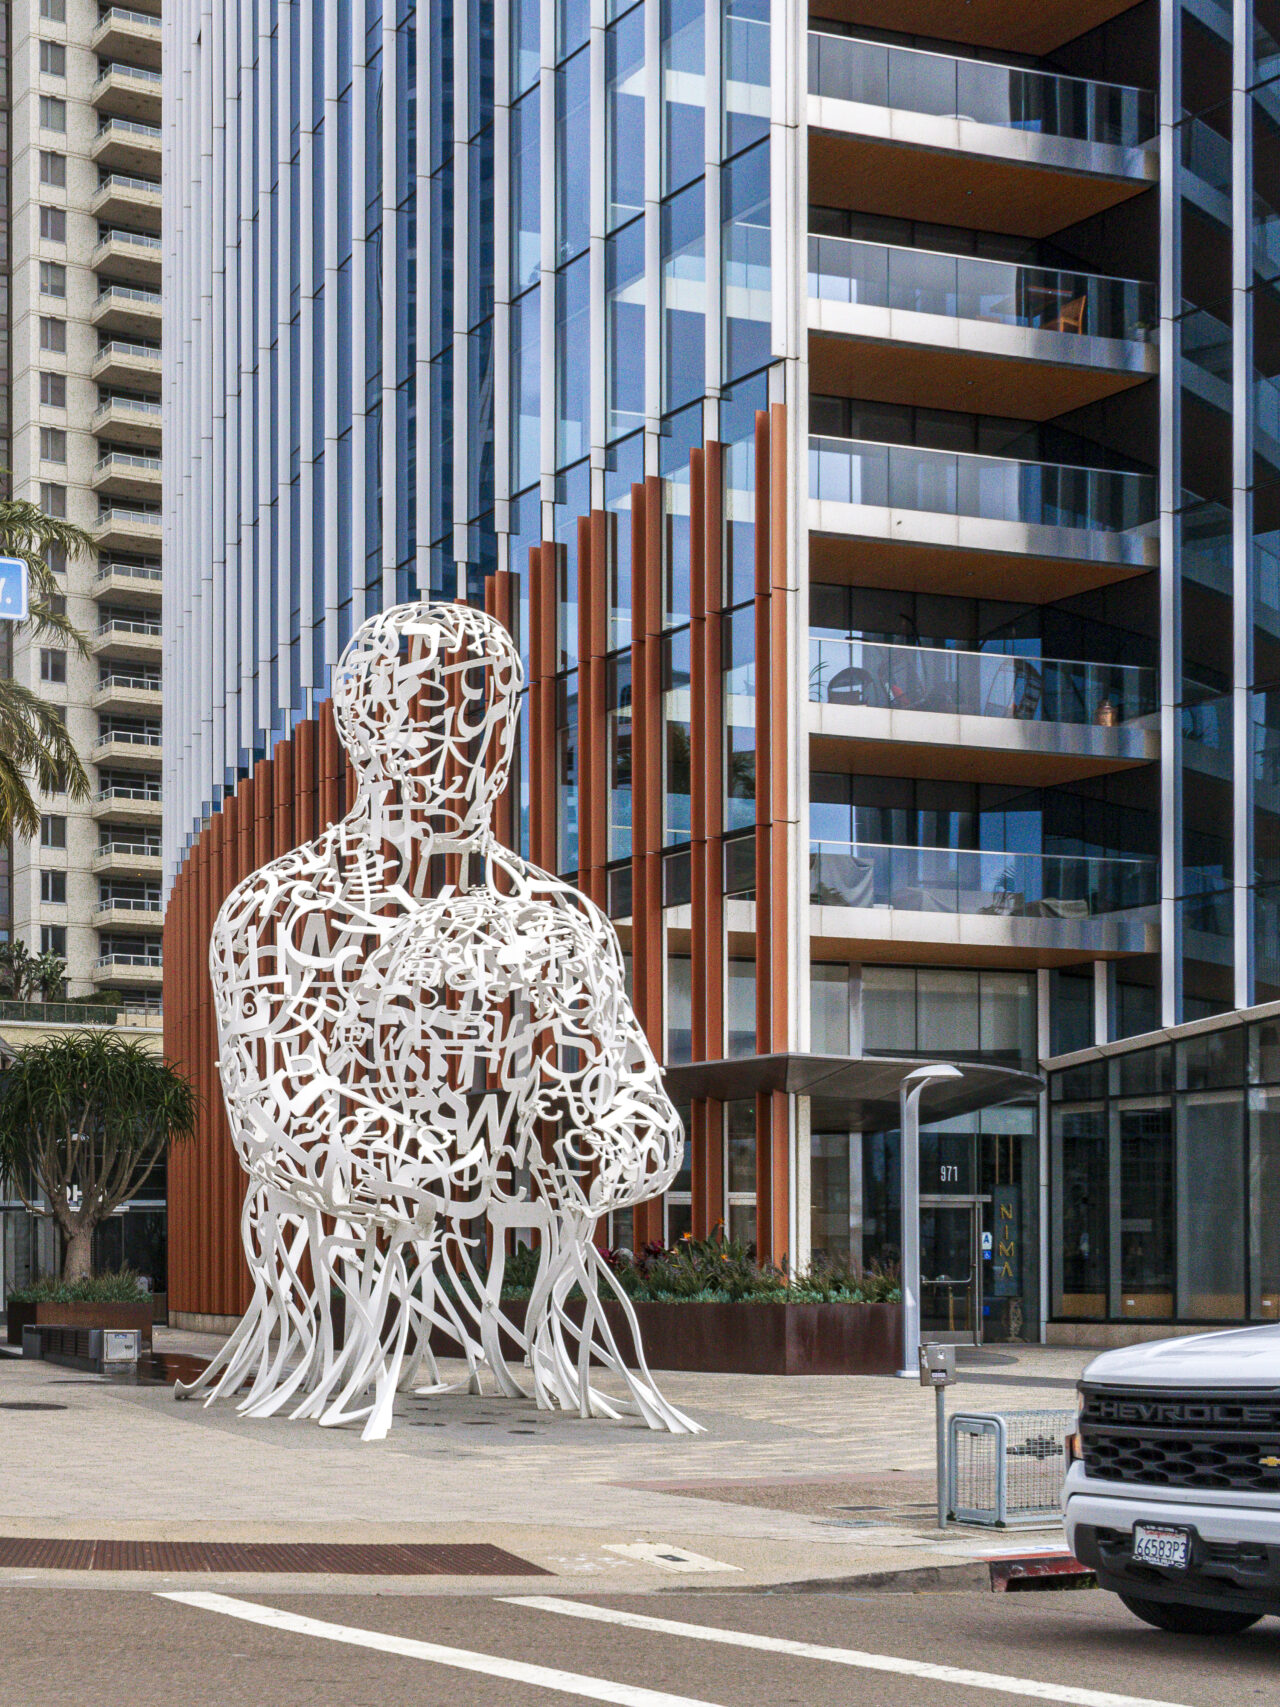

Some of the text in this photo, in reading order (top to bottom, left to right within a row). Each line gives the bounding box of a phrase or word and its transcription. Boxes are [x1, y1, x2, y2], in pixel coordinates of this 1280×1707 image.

[940, 1165, 958, 1182] 971
[983, 1234, 989, 1243] A
[999, 1203, 1014, 1277] NIMA
[1137, 1538, 1187, 1559] 66583P3
